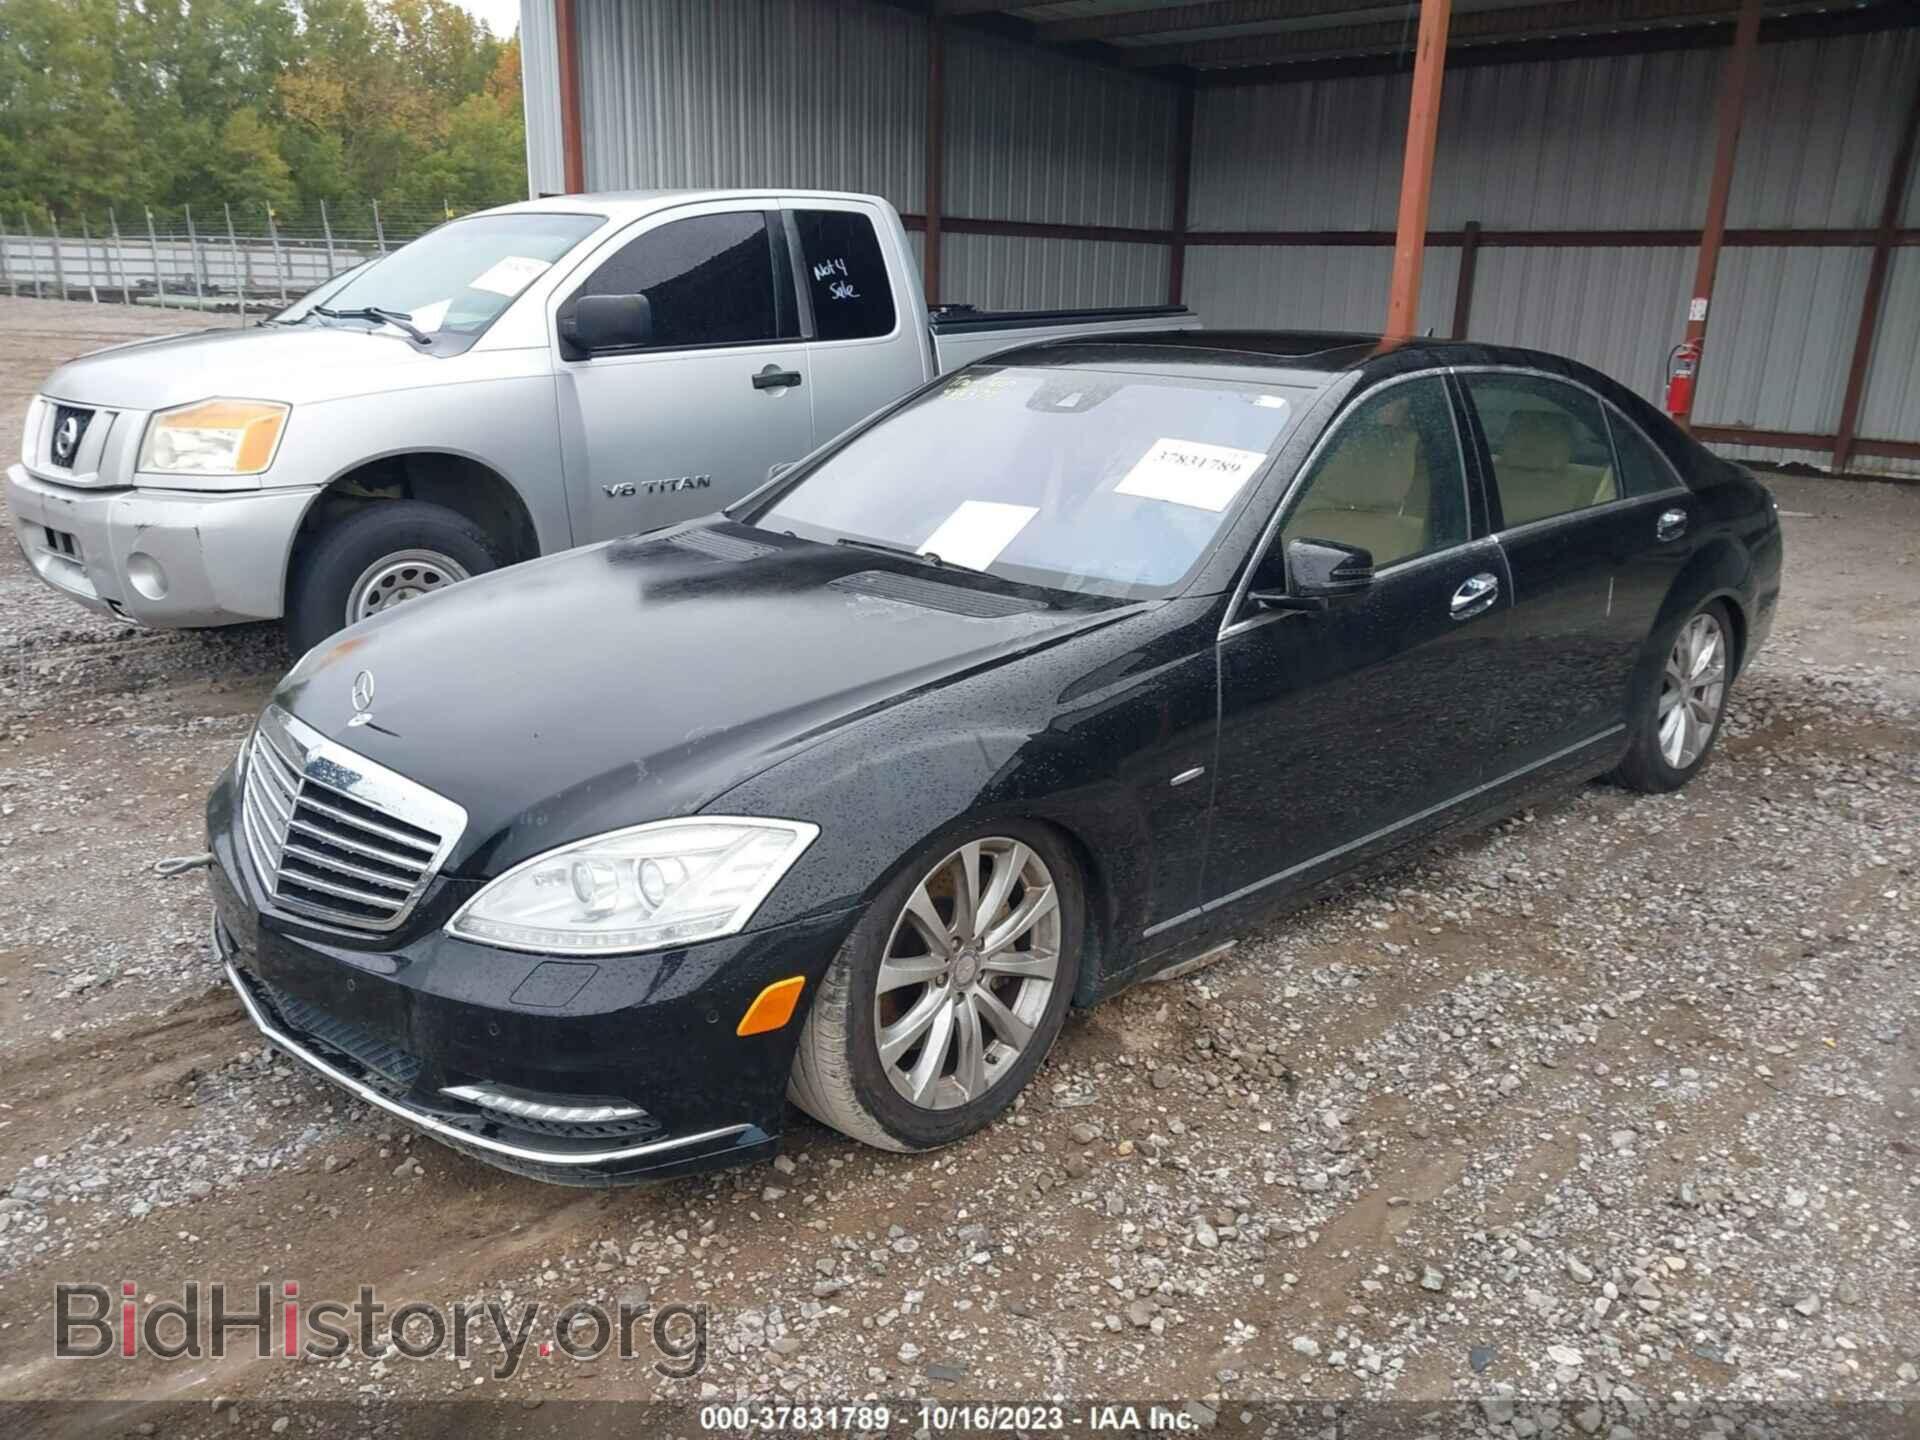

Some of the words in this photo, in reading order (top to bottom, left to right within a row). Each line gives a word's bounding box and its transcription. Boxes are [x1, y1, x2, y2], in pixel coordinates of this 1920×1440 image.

[813, 259, 836, 281] Not
[834, 258, 849, 277] 4
[829, 280, 861, 300] Sale
[1154, 451, 1242, 473] 37831789
[602, 482, 636, 498] V8
[641, 474, 712, 494] TITAN
